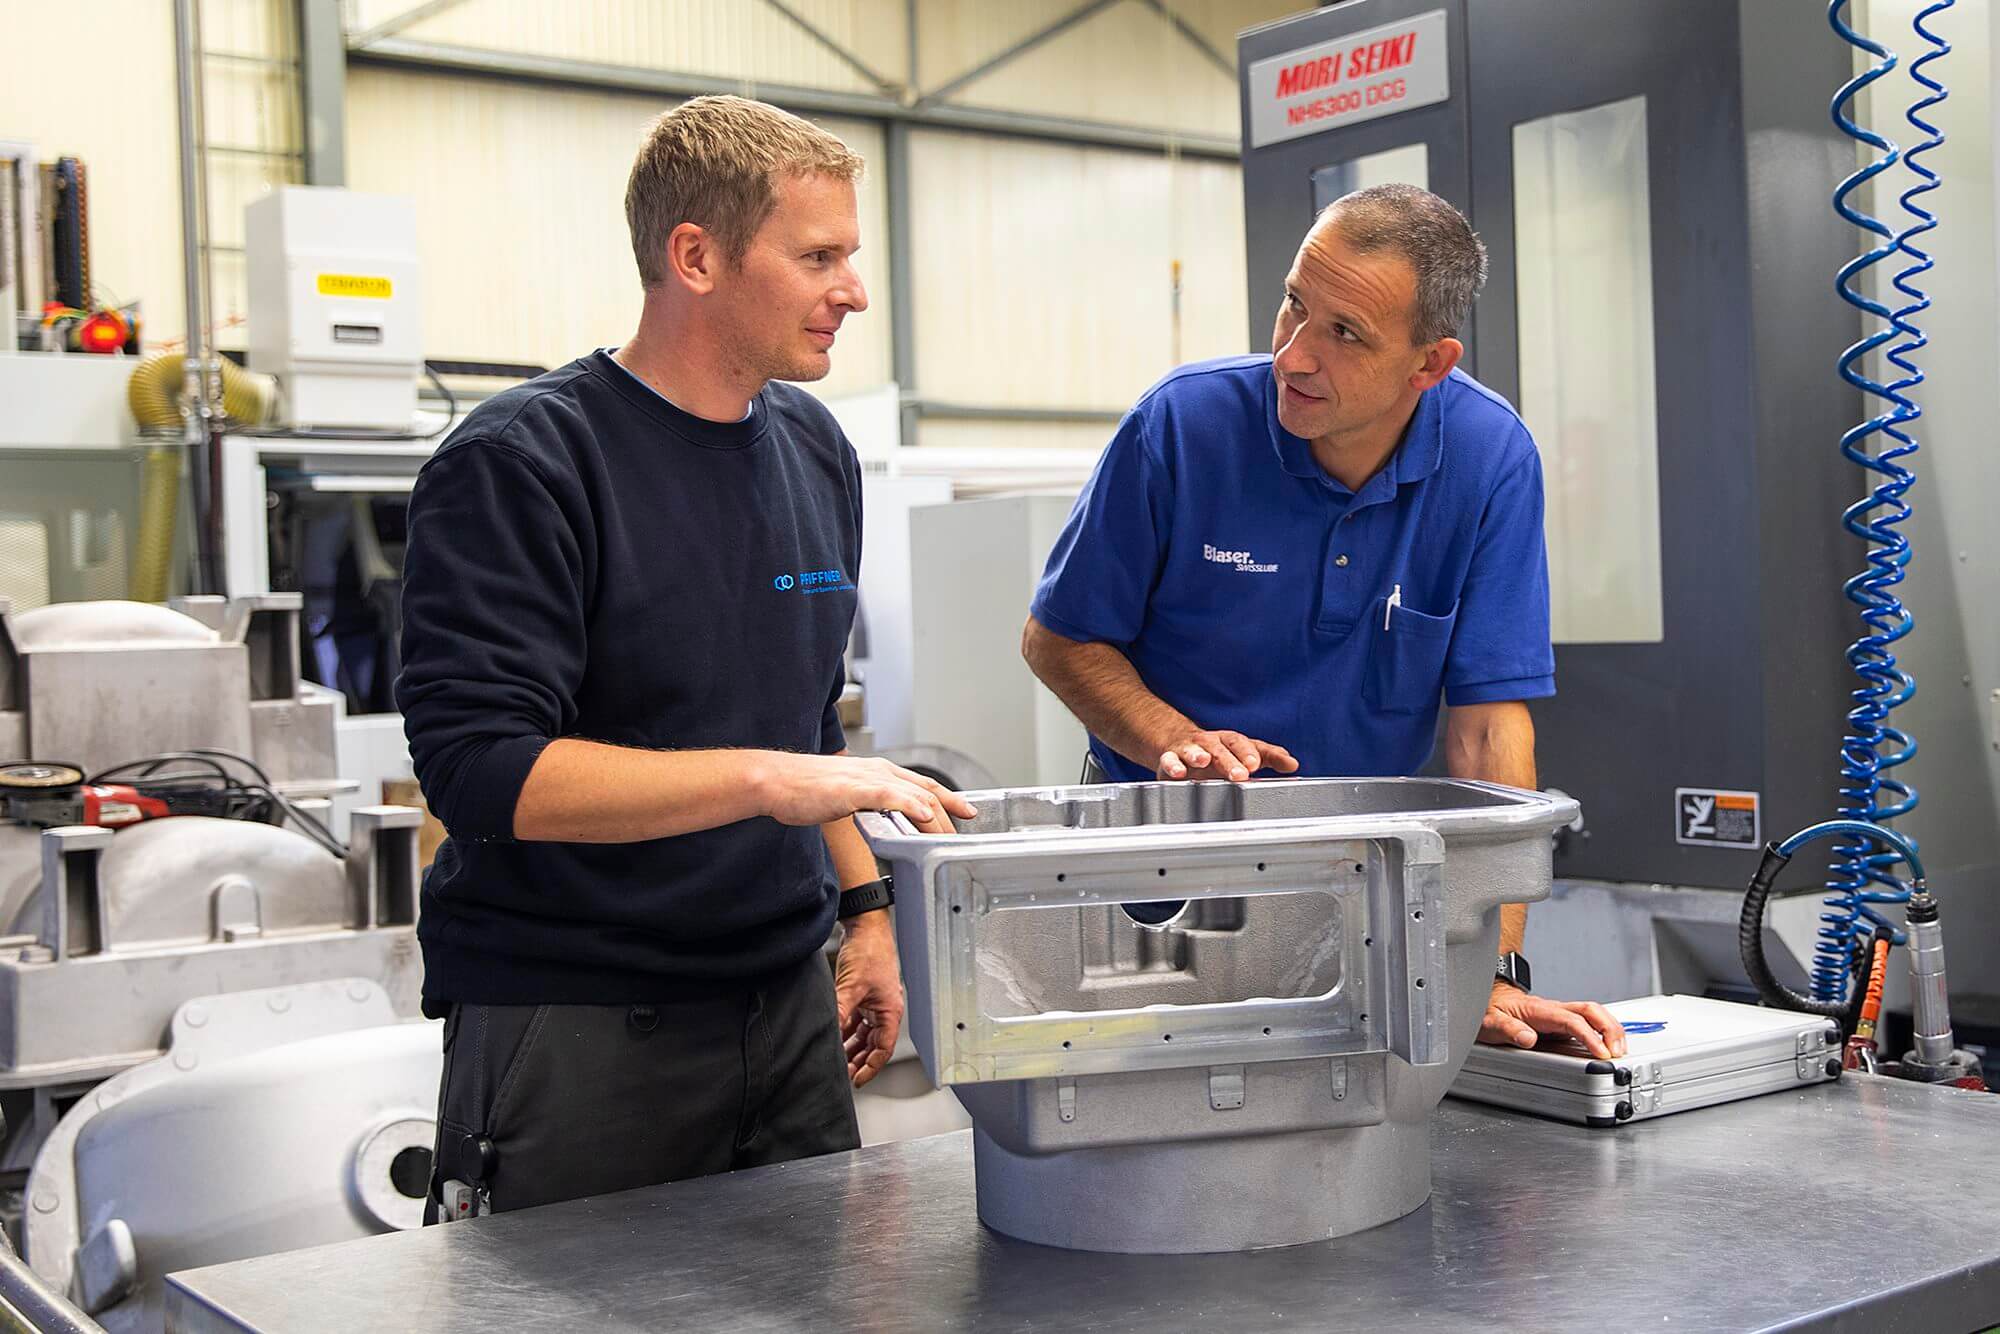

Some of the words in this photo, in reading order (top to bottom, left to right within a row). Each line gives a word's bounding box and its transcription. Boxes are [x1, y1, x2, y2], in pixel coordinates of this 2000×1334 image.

[1276, 53, 1343, 98] MORI
[1347, 32, 1417, 79] SEIKI
[1287, 90, 1361, 125] NH6300
[1366, 78, 1406, 105] DCG
[1203, 543, 1254, 564] Blaser.
